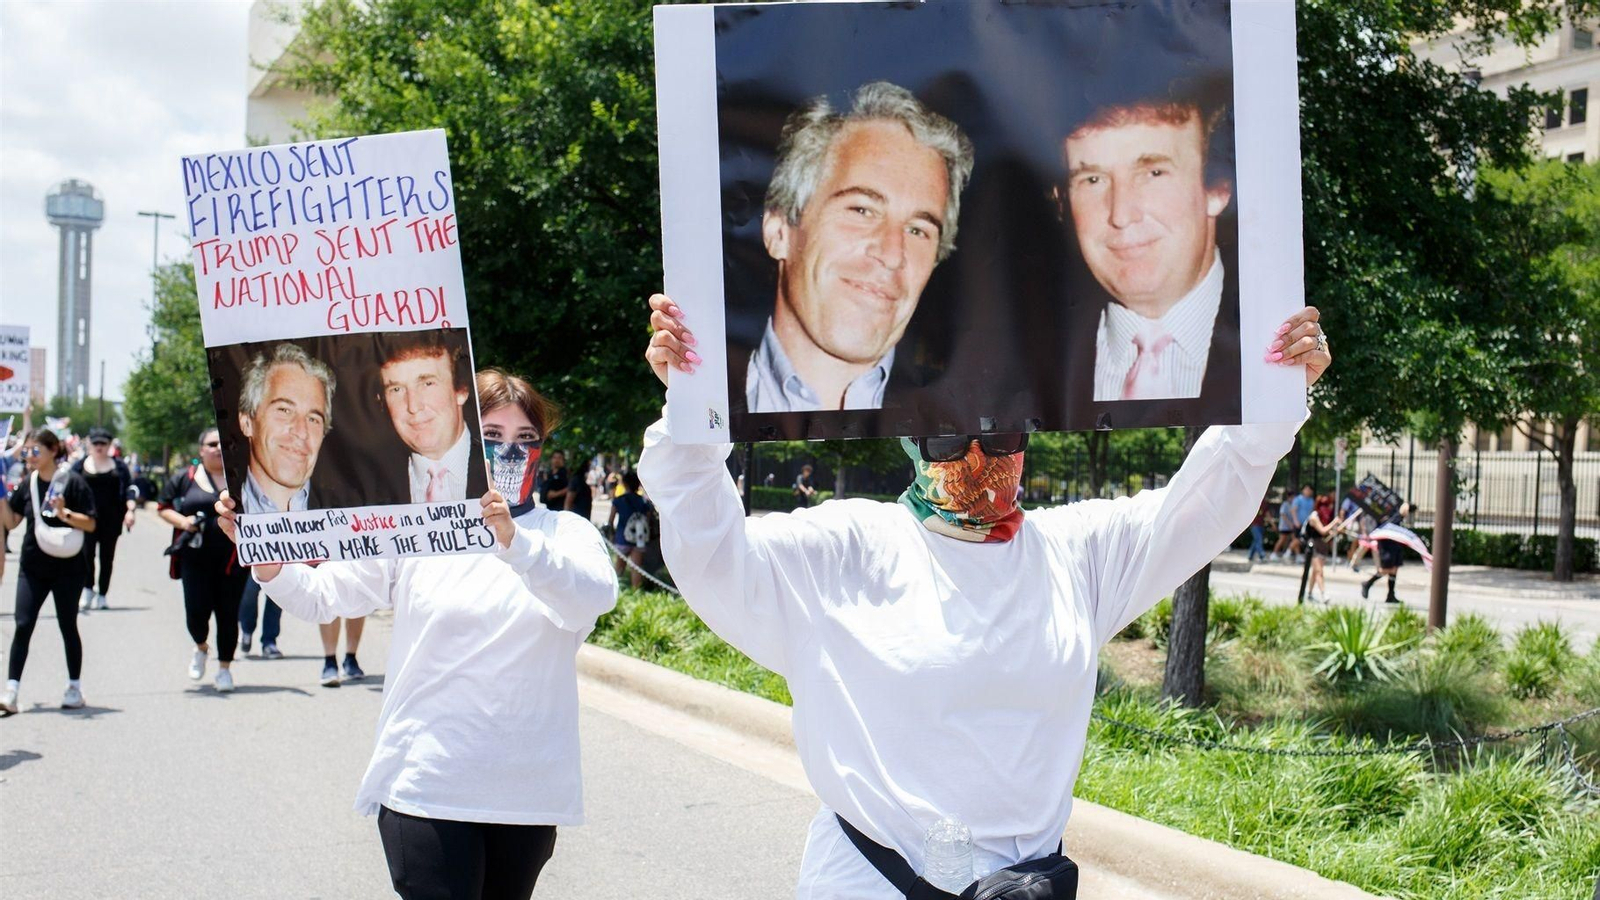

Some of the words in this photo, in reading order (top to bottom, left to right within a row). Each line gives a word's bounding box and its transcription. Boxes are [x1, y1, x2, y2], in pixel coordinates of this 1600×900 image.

[182, 150, 281, 196] MEXICO
[289, 137, 359, 183] SENT
[189, 170, 449, 237] FIREFIGHTERS
[193, 233, 298, 275] TRUMP
[315, 218, 399, 266] SENT
[406, 214, 457, 253] THE
[214, 266, 371, 310] NATIONAL
[327, 286, 451, 332] GUARD!
[239, 540, 331, 564] CRIMINALS
[339, 534, 384, 560] MAKE
[390, 534, 422, 555] THE
[427, 525, 495, 553] RULES
[266, 517, 294, 537] will
[293, 519, 325, 533] never
[351, 513, 397, 533] Justice
[400, 514, 413, 528] in
[416, 515, 424, 526] a
[449, 517, 485, 530] wher
